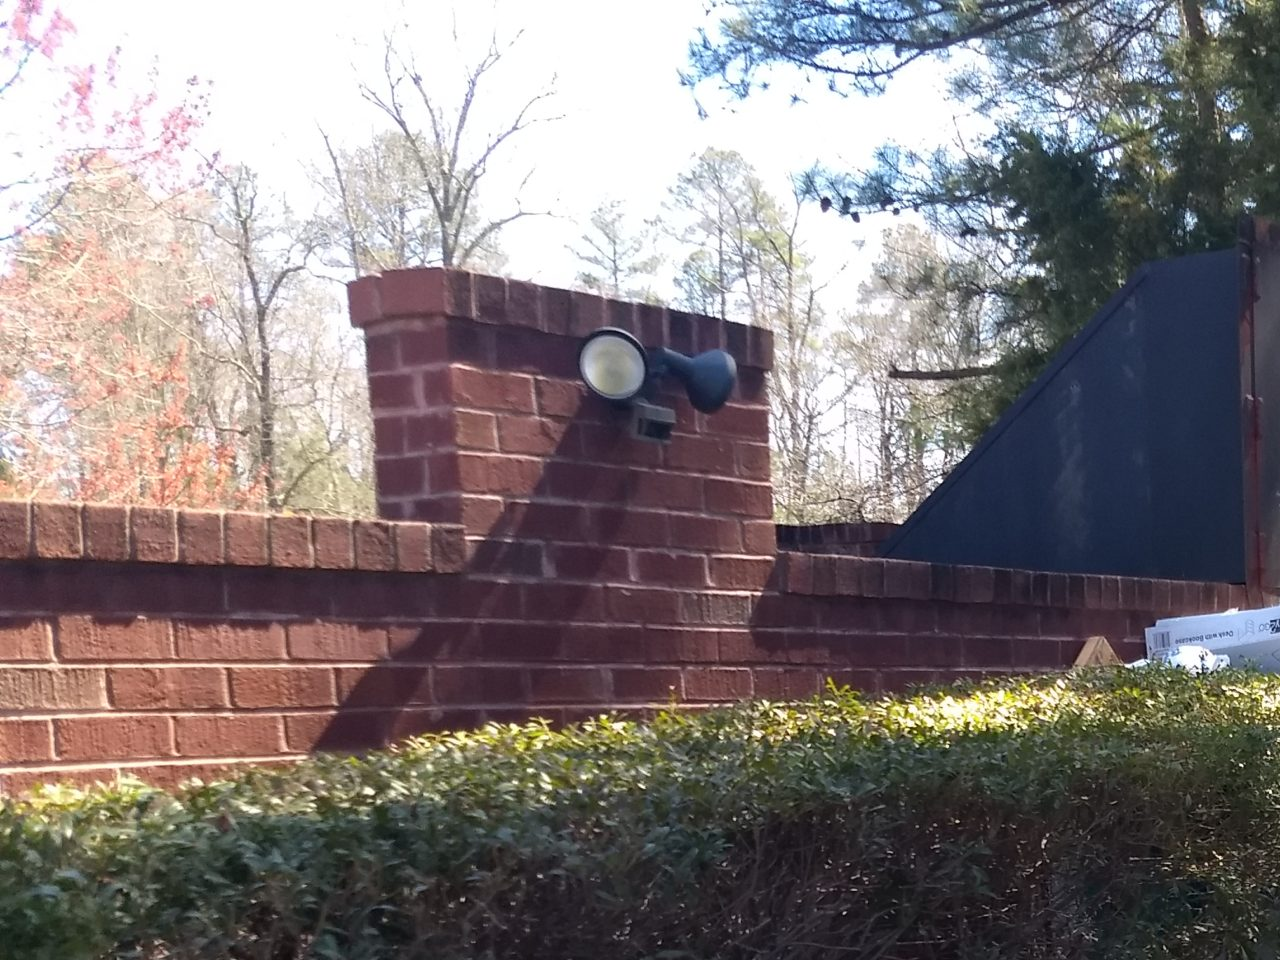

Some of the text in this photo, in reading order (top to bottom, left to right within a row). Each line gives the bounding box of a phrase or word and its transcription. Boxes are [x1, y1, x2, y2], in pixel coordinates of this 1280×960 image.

[1175, 630, 1234, 645] Desk with Bookcase
